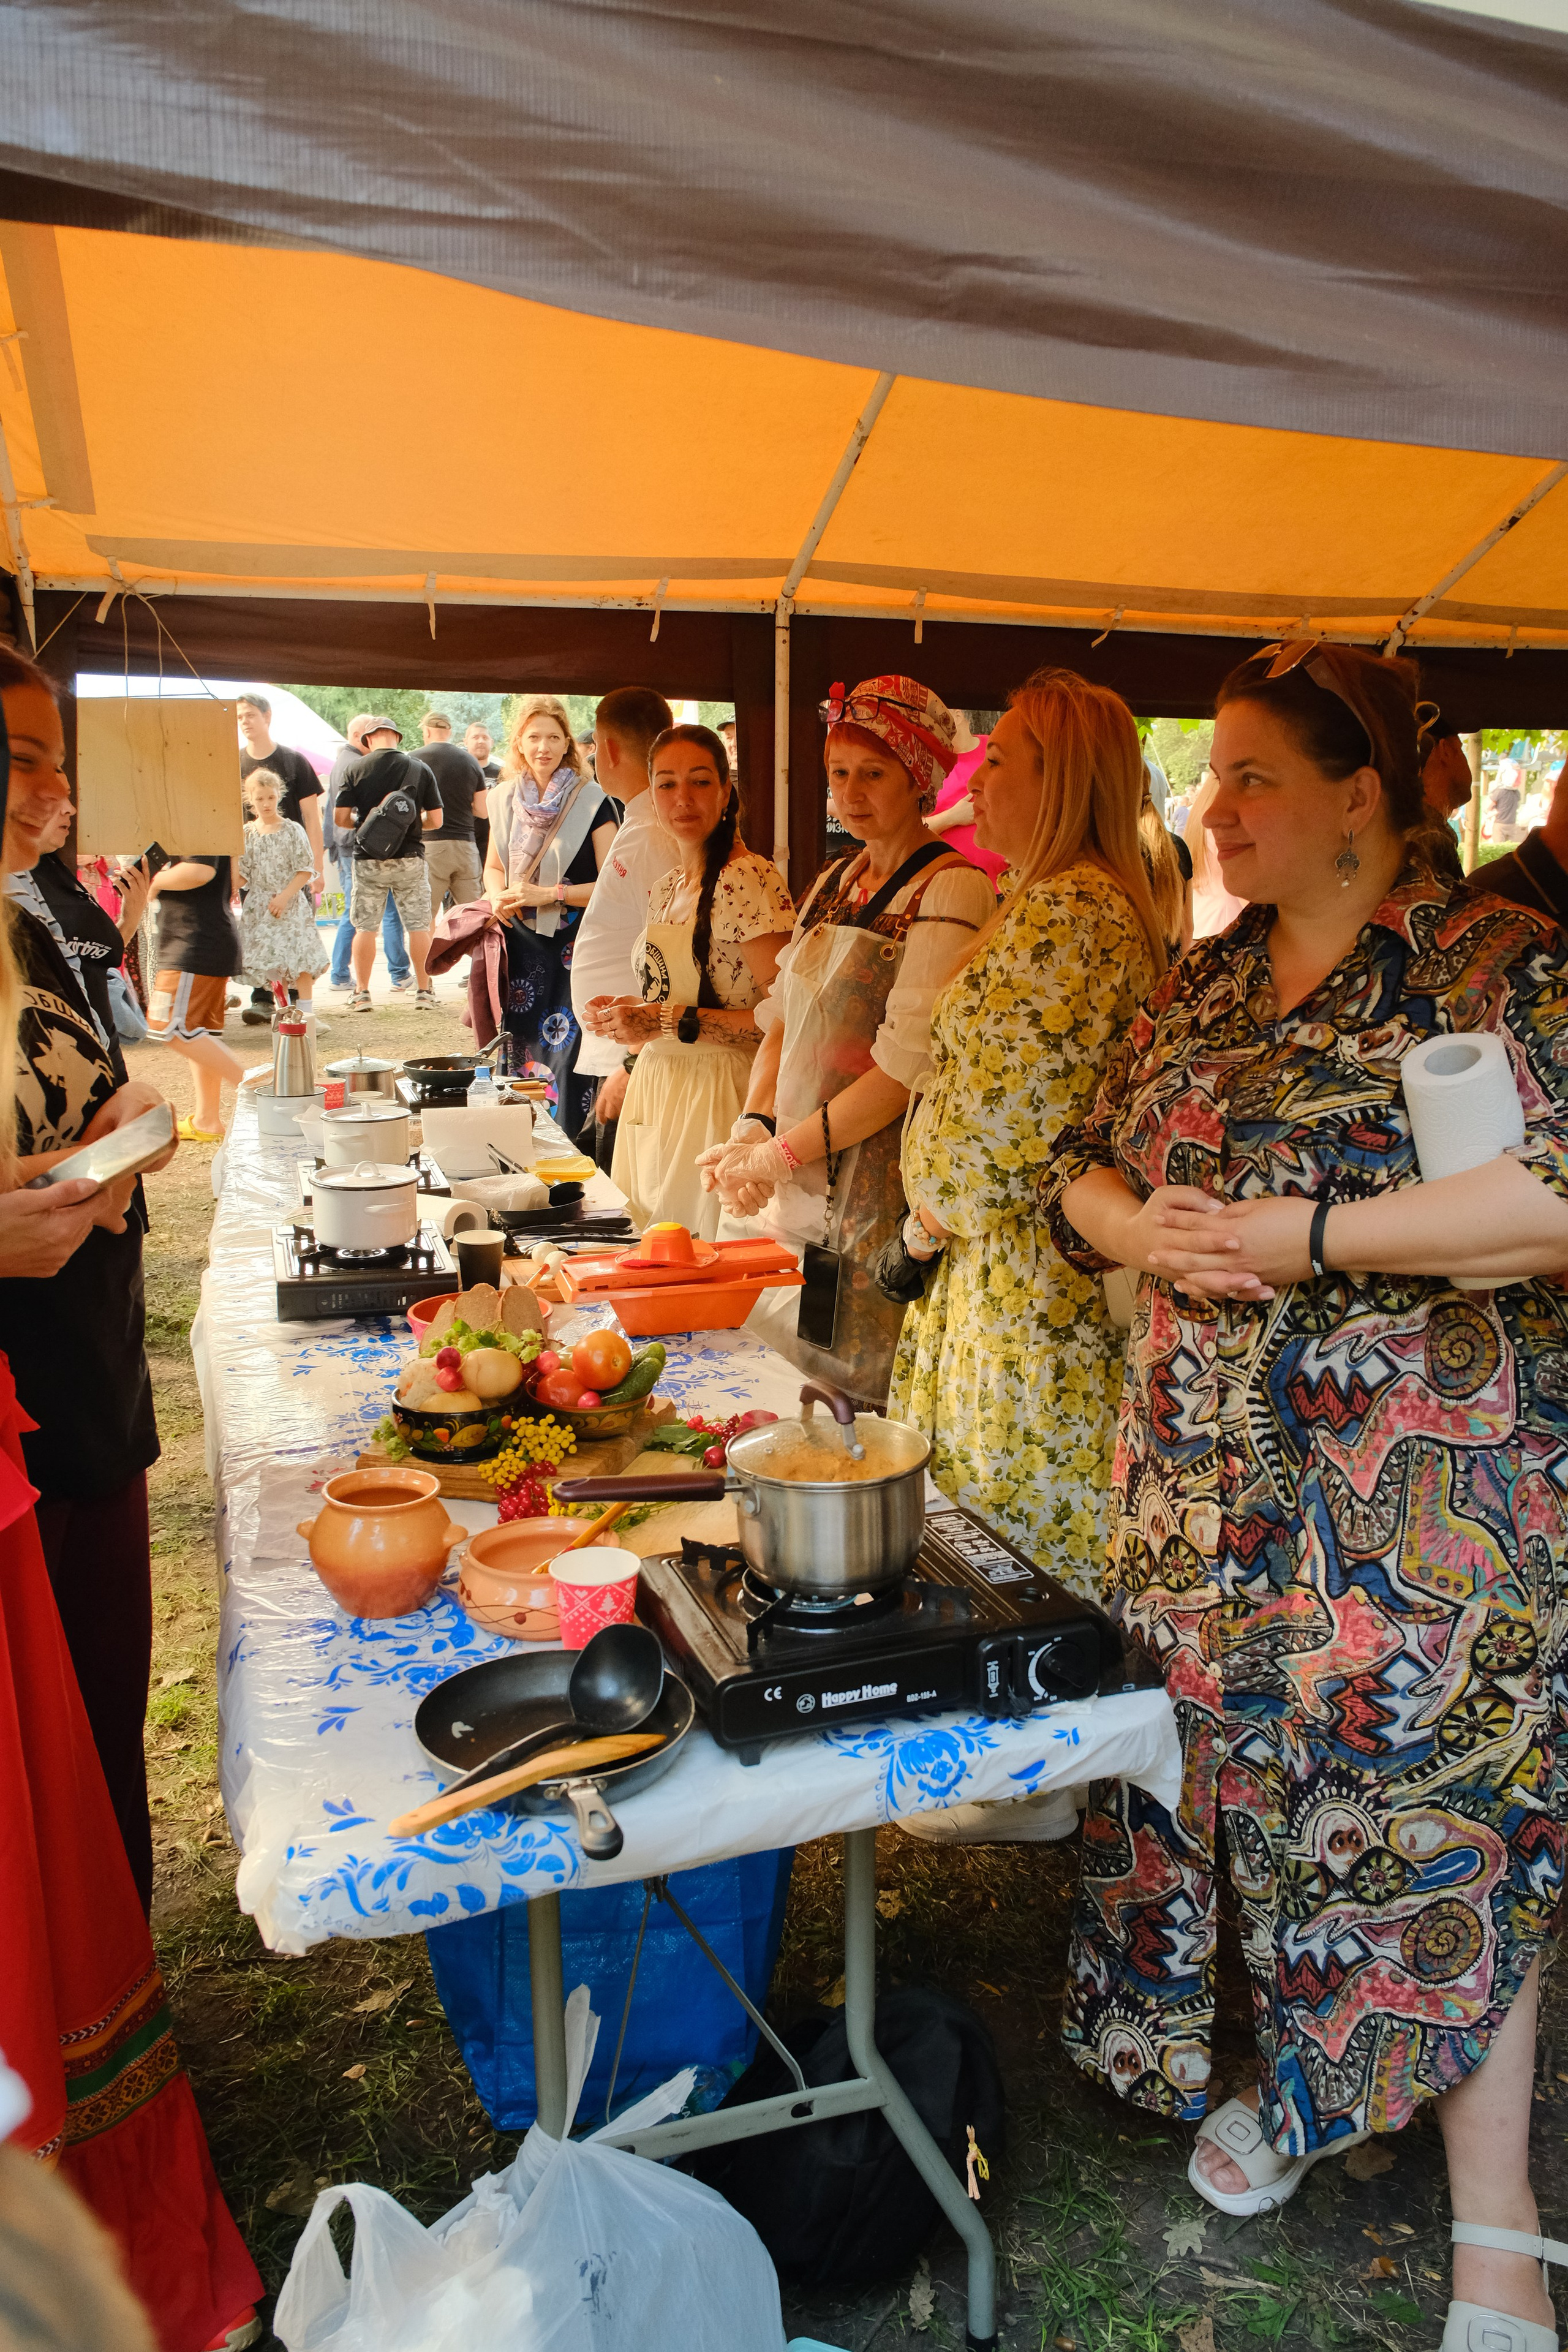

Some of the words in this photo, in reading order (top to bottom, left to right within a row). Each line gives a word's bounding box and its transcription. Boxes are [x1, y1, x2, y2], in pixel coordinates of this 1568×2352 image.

[646, 944, 668, 979] ОБЩИНА
[764, 1686, 782, 1702] CE
[821, 1688, 861, 1708] Happy
[862, 1682, 897, 1698] Home
